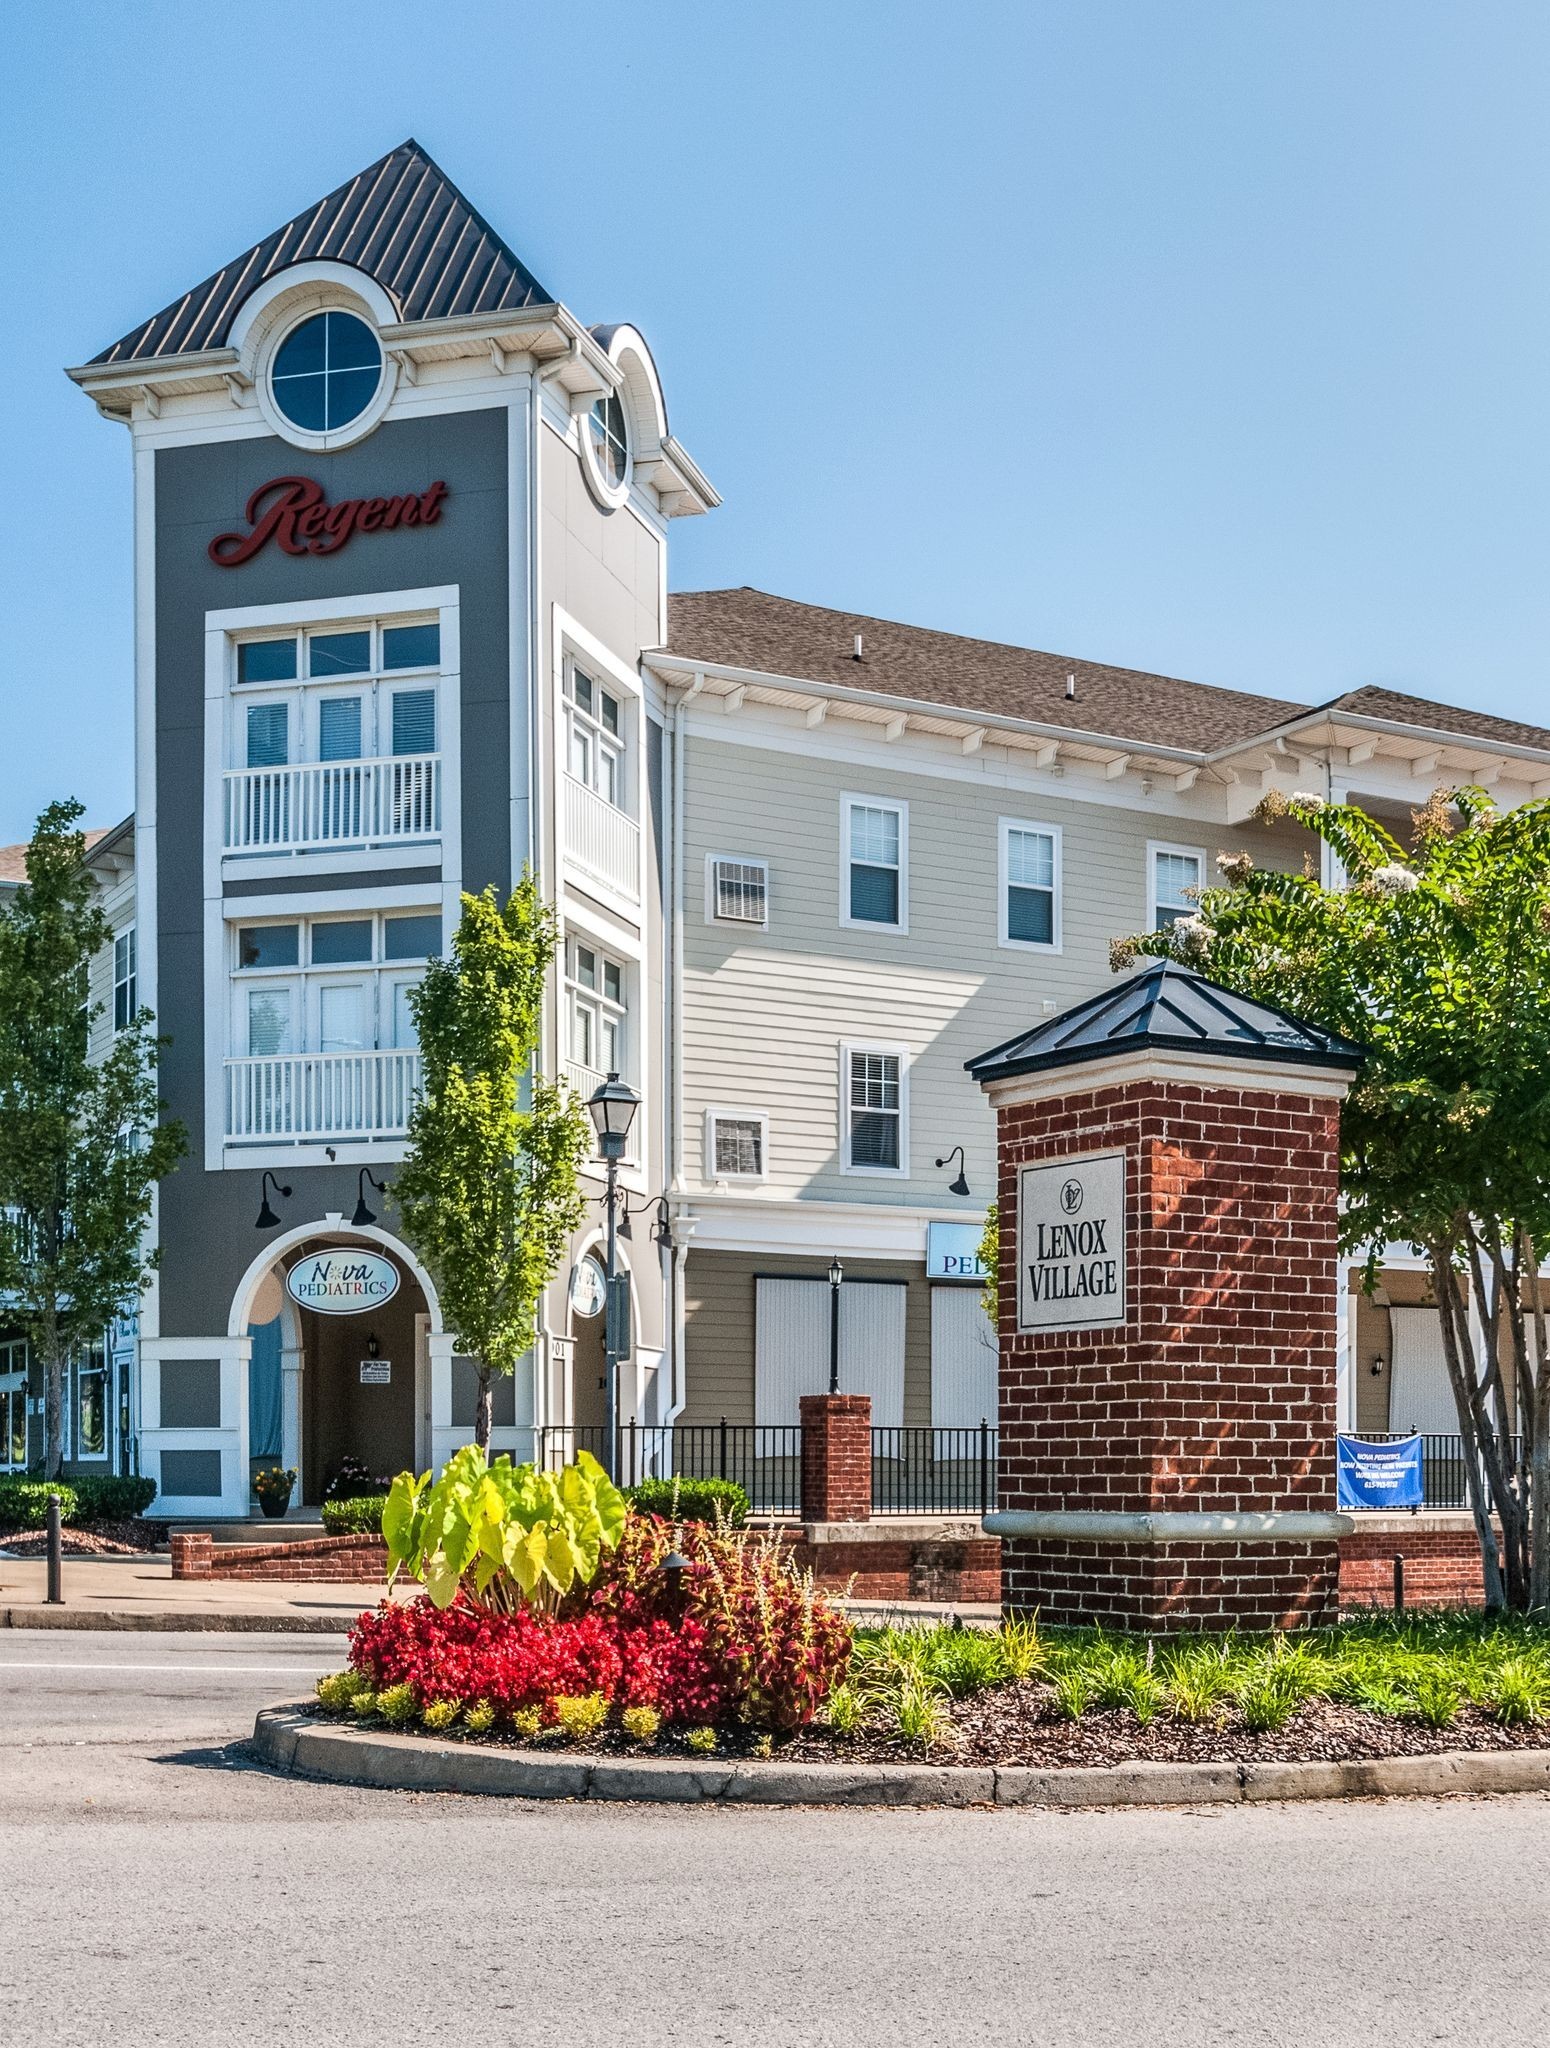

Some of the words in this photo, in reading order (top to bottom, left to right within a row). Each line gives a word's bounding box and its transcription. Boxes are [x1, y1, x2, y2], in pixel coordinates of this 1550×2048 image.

[208, 476, 448, 566] Regent
[1037, 1219, 1107, 1260] LENOX
[298, 1281, 388, 1296] PEDIATRICS
[1028, 1260, 1117, 1302] VILLAGE
